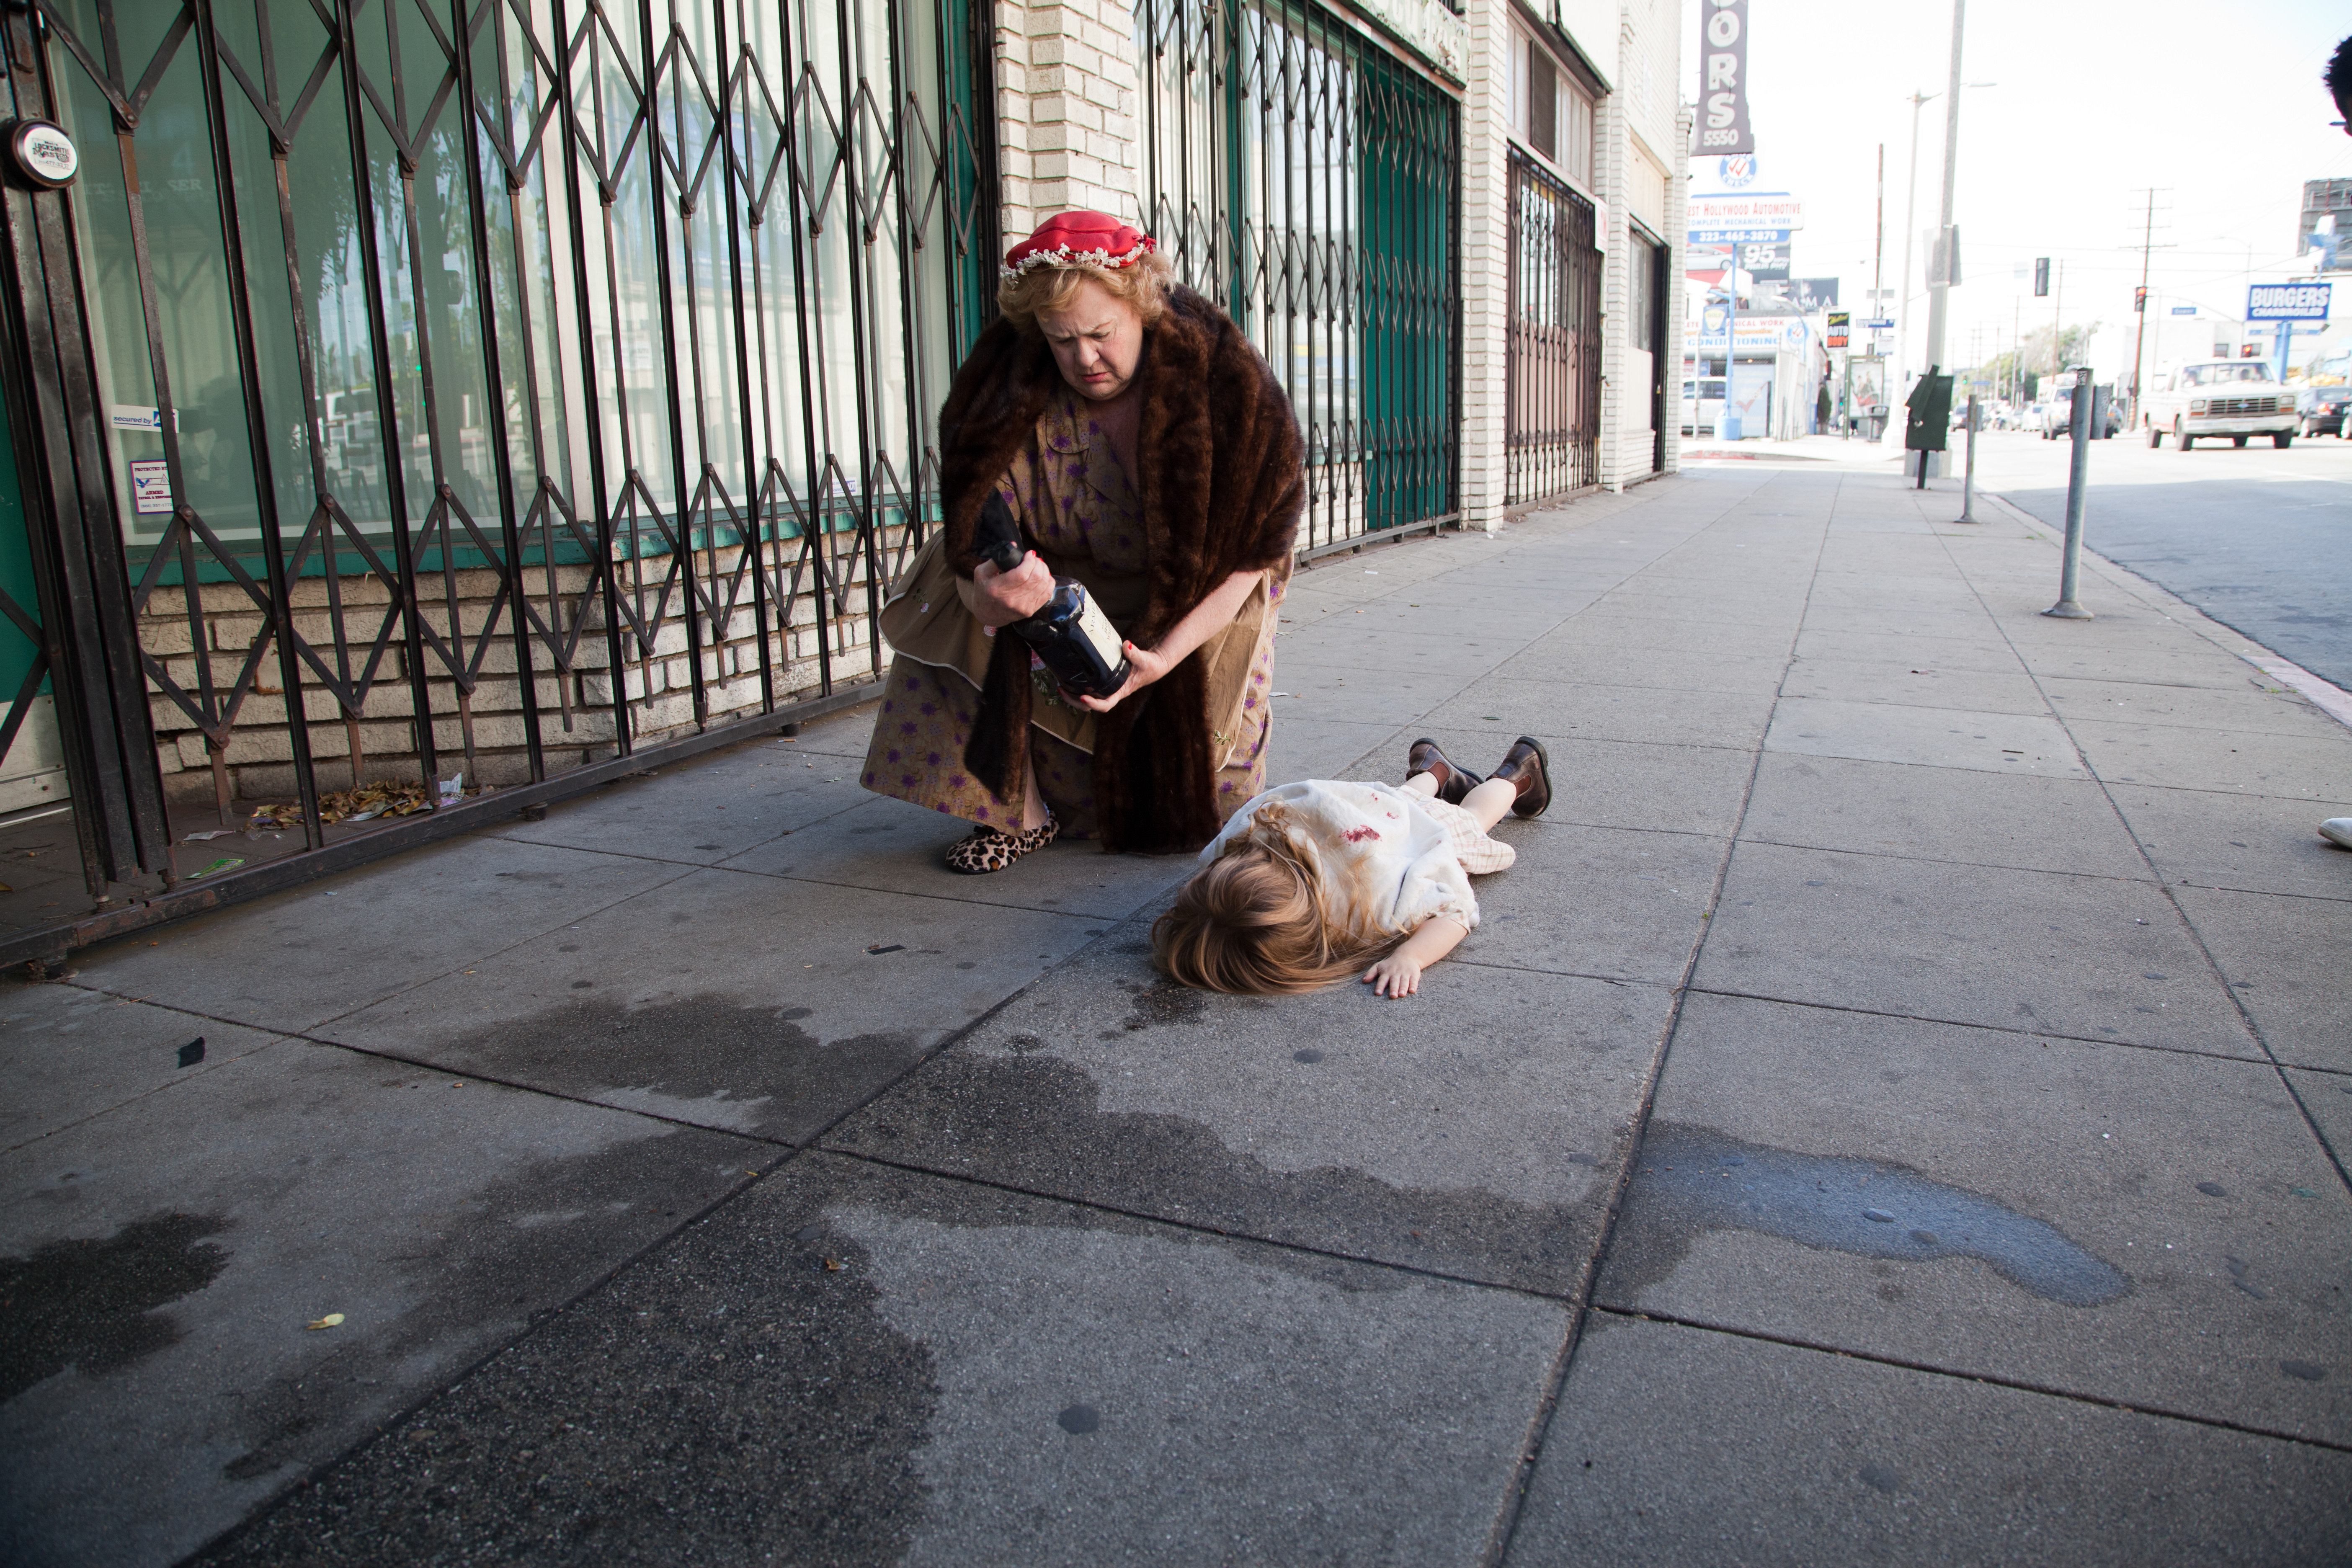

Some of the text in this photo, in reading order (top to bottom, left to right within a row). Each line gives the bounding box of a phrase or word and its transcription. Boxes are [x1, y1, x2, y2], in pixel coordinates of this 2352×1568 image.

[1707, 0, 1740, 128] ORS
[1703, 129, 1739, 147] 5550
[34, 142, 70, 155] LOCKSMITH
[1722, 173, 1754, 187] CHECK
[1688, 202, 1801, 217] EST HOLLYWOOD AUTOMOTIVE
[1699, 230, 1778, 242] 323-465-3870
[1743, 244, 1776, 264] 95
[2250, 286, 2329, 308] BURGERS
[2252, 307, 2324, 317] CHARBROILED
[1828, 325, 1849, 337] AUTO
[1827, 336, 1848, 347] BODY
